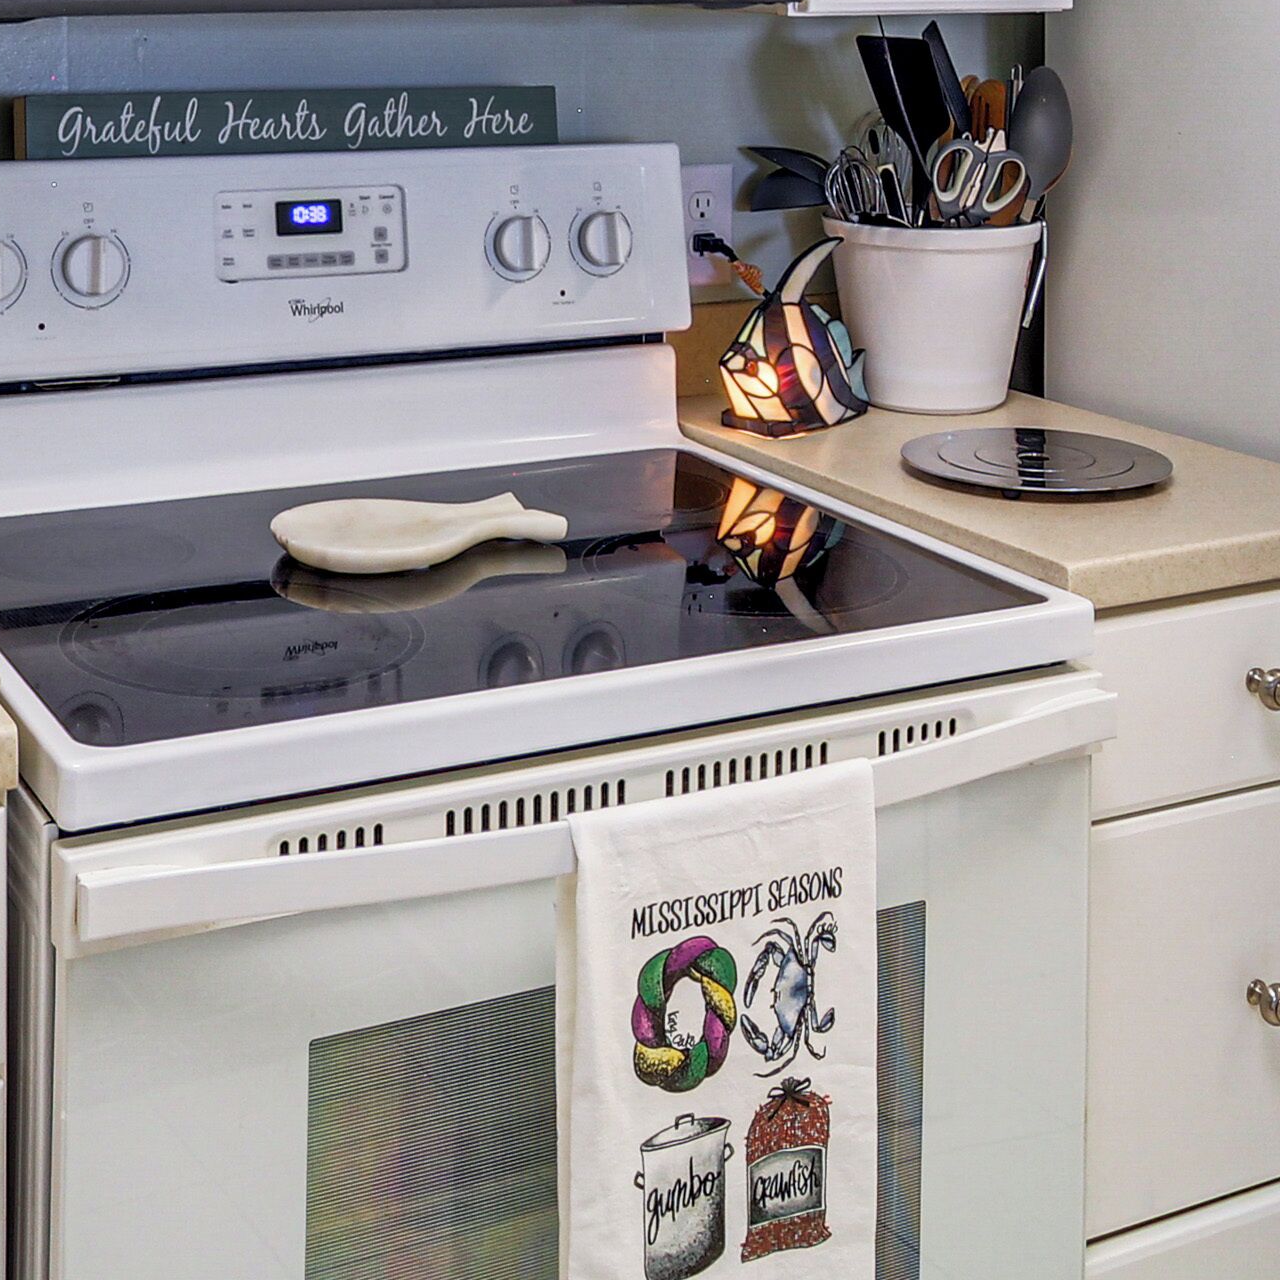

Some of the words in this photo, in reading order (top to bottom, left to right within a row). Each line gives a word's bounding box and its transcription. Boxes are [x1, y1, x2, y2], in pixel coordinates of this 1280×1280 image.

[58, 95, 202, 156] Grateful
[218, 98, 327, 145] Hearts
[343, 91, 448, 149] Gather
[463, 95, 534, 138] Here
[289, 298, 344, 322] Whirlpool
[631, 883, 763, 939] MISSISSIPPI
[767, 866, 843, 912] SEASONS
[647, 1156, 721, 1245] gumbo
